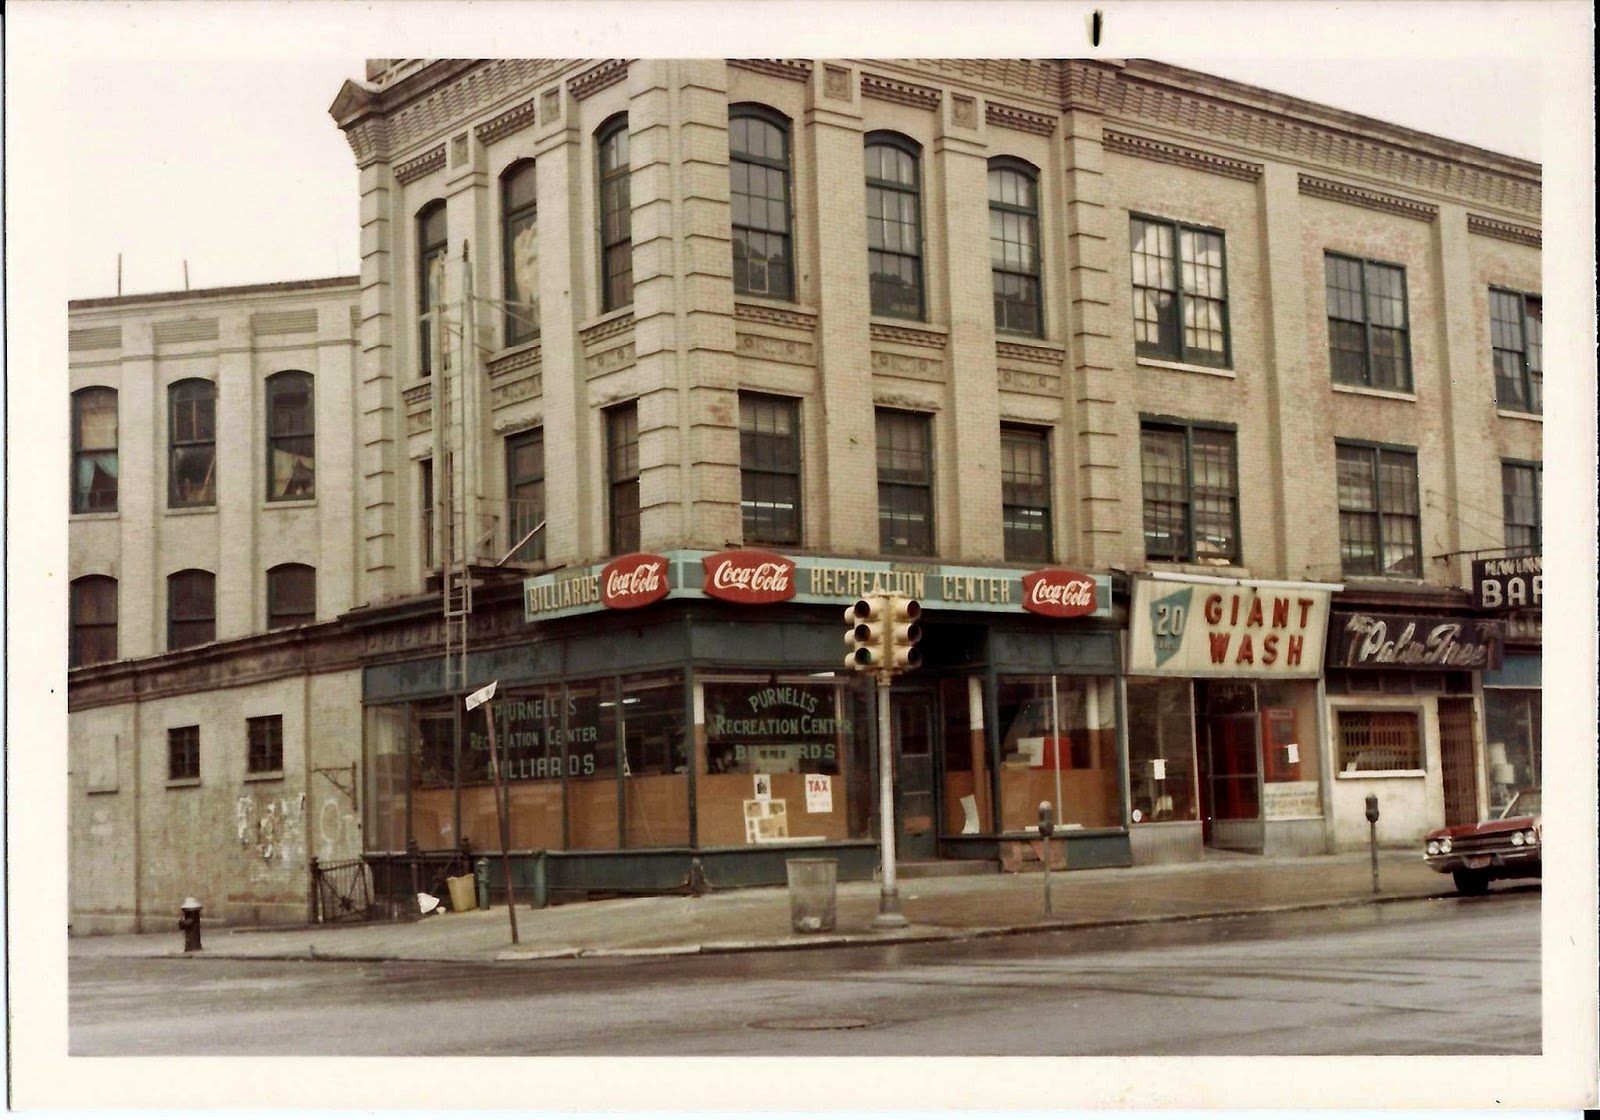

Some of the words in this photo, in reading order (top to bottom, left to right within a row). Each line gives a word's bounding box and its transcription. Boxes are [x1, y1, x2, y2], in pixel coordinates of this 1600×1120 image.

[606, 561, 660, 599] Coca-Cola
[713, 559, 789, 592] Coca-Cola
[810, 568, 925, 600] RECREATION
[942, 575, 1010, 603] CENTER
[527, 574, 600, 613] BILLIARDS
[1031, 578, 1092, 607] Coca-Cola
[1156, 604, 1184, 637] 20
[1204, 592, 1314, 629] GIANT
[1208, 631, 1304, 666] WASH
[747, 687, 819, 713] PURNELL'S
[713, 714, 799, 735] RECREATION
[469, 731, 539, 752] RECEATION
[734, 742, 836, 761] BIIRDS
[808, 779, 829, 793] TAX
